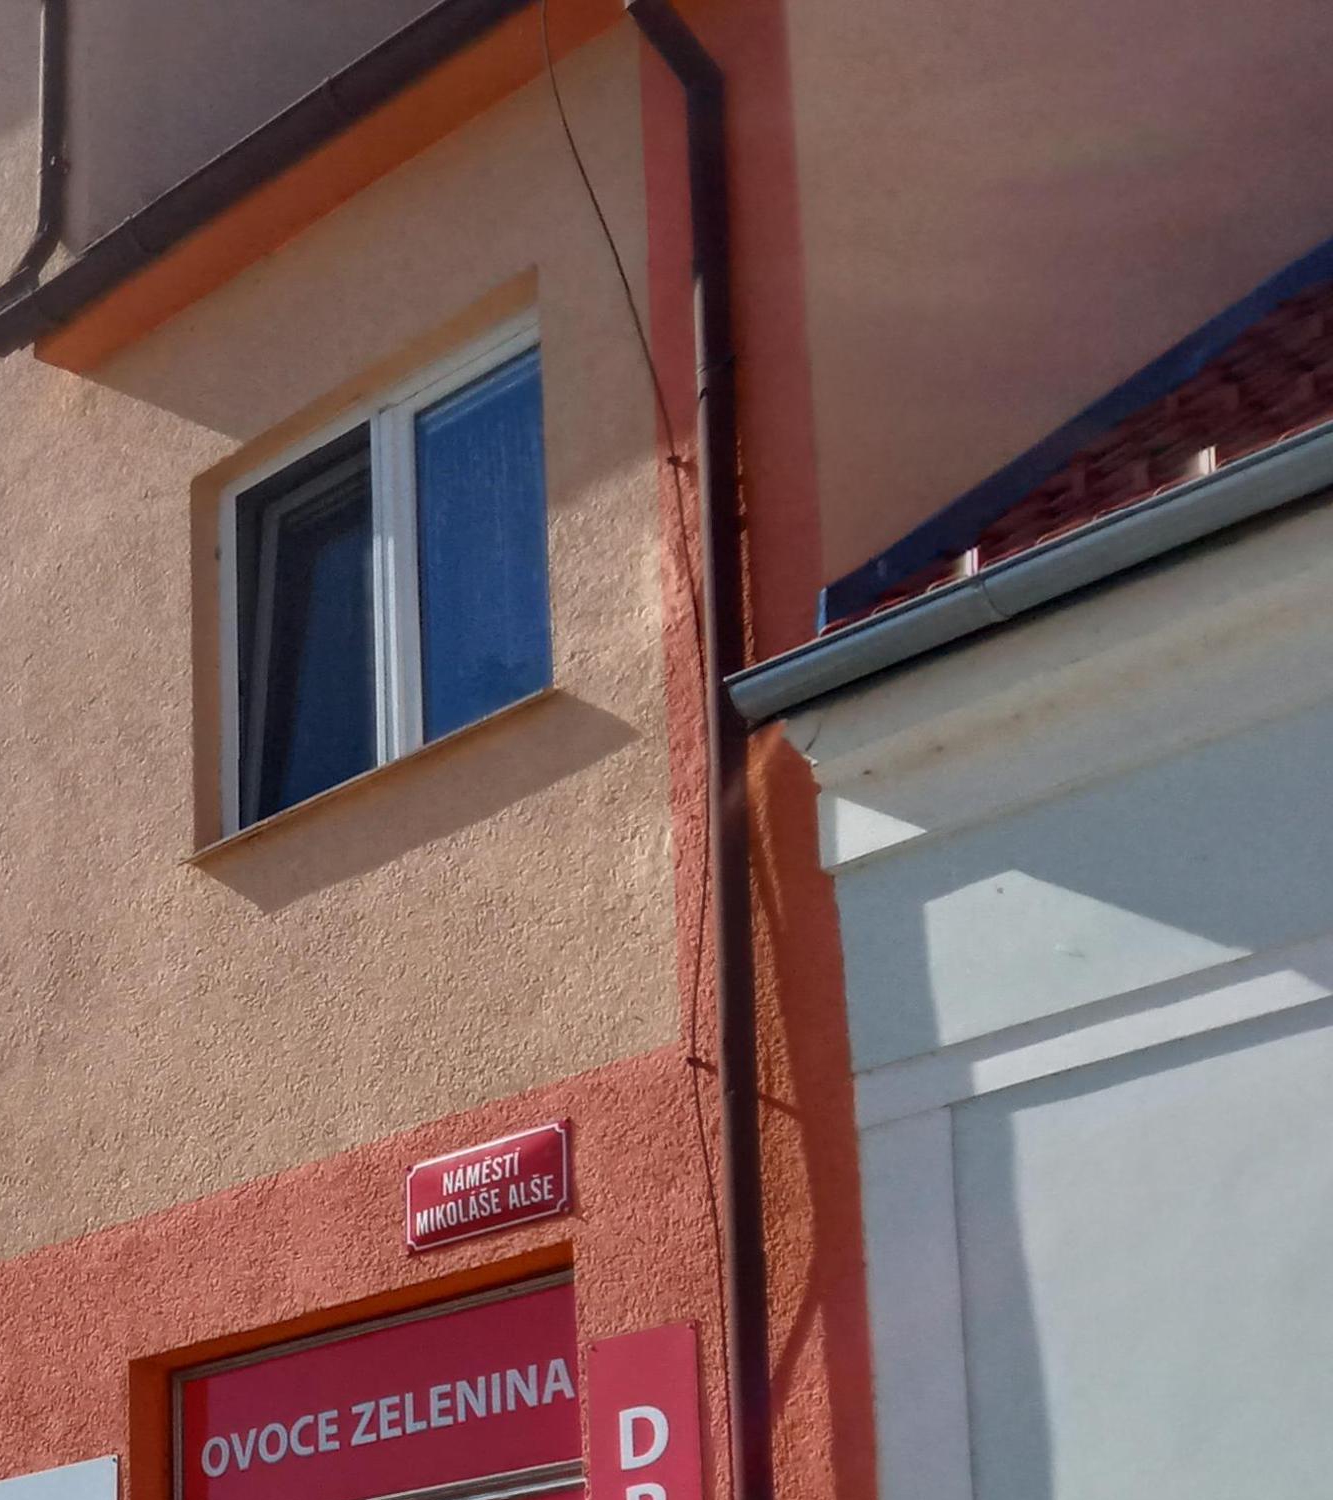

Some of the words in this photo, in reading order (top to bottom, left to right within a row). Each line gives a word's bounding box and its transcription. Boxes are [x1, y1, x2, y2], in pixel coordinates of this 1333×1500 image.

[442, 1147, 521, 1196] NÁMĚSTÍ
[415, 1187, 502, 1237] MIKOLÁŠE
[508, 1173, 555, 1211] ALŠE
[200, 1408, 340, 1478] OVOCE
[349, 1357, 576, 1448] ZELENINA
